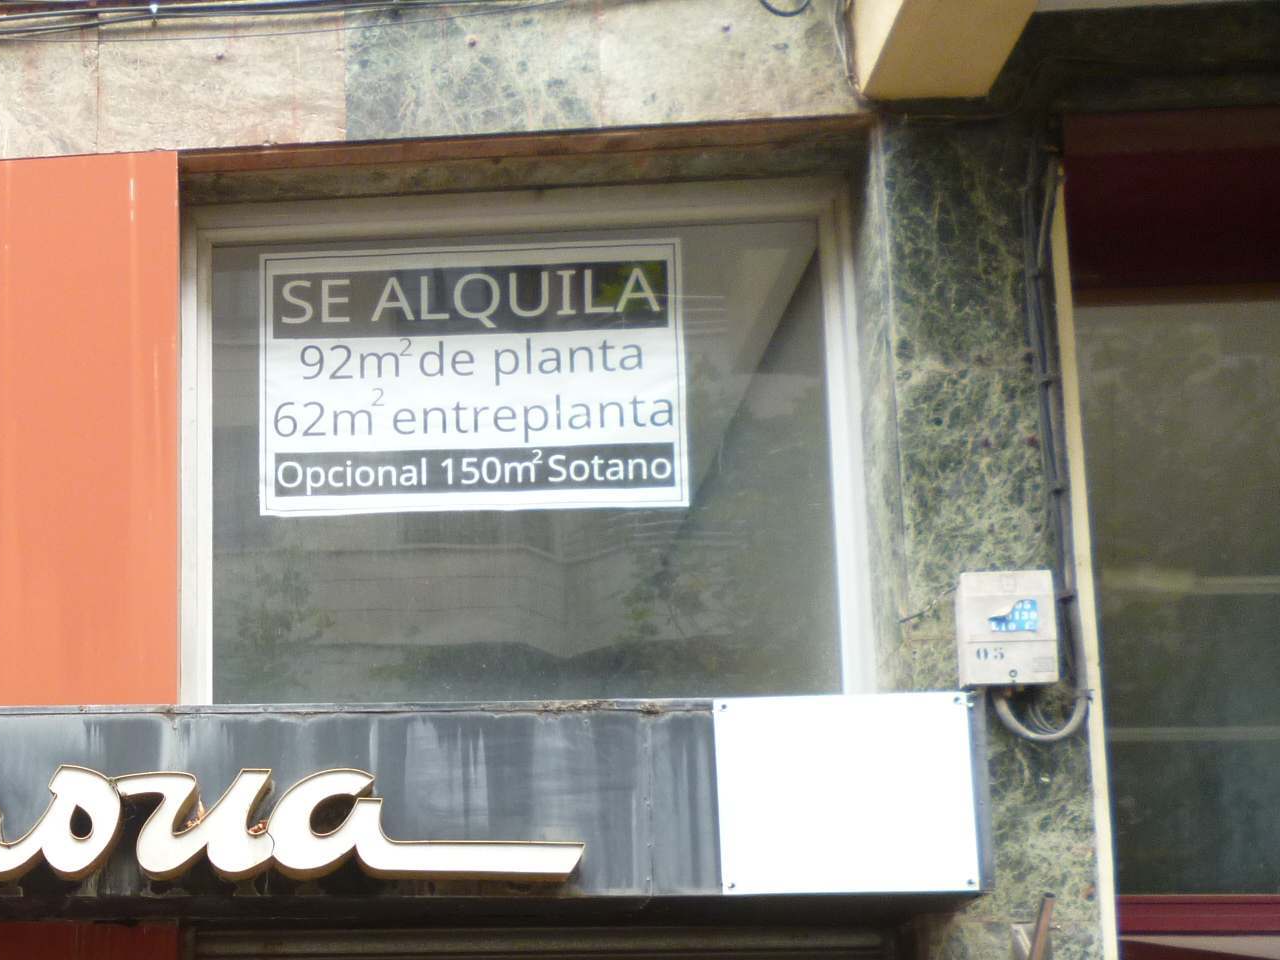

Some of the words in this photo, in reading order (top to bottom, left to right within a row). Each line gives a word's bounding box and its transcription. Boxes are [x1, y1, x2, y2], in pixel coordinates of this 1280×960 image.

[281, 278, 351, 324] SE
[370, 266, 662, 328] ALQUILA
[419, 340, 475, 377] de
[495, 337, 644, 386] planta
[393, 393, 674, 443] entreplanta
[277, 457, 427, 496] Opcional
[548, 453, 672, 483] Sotano
